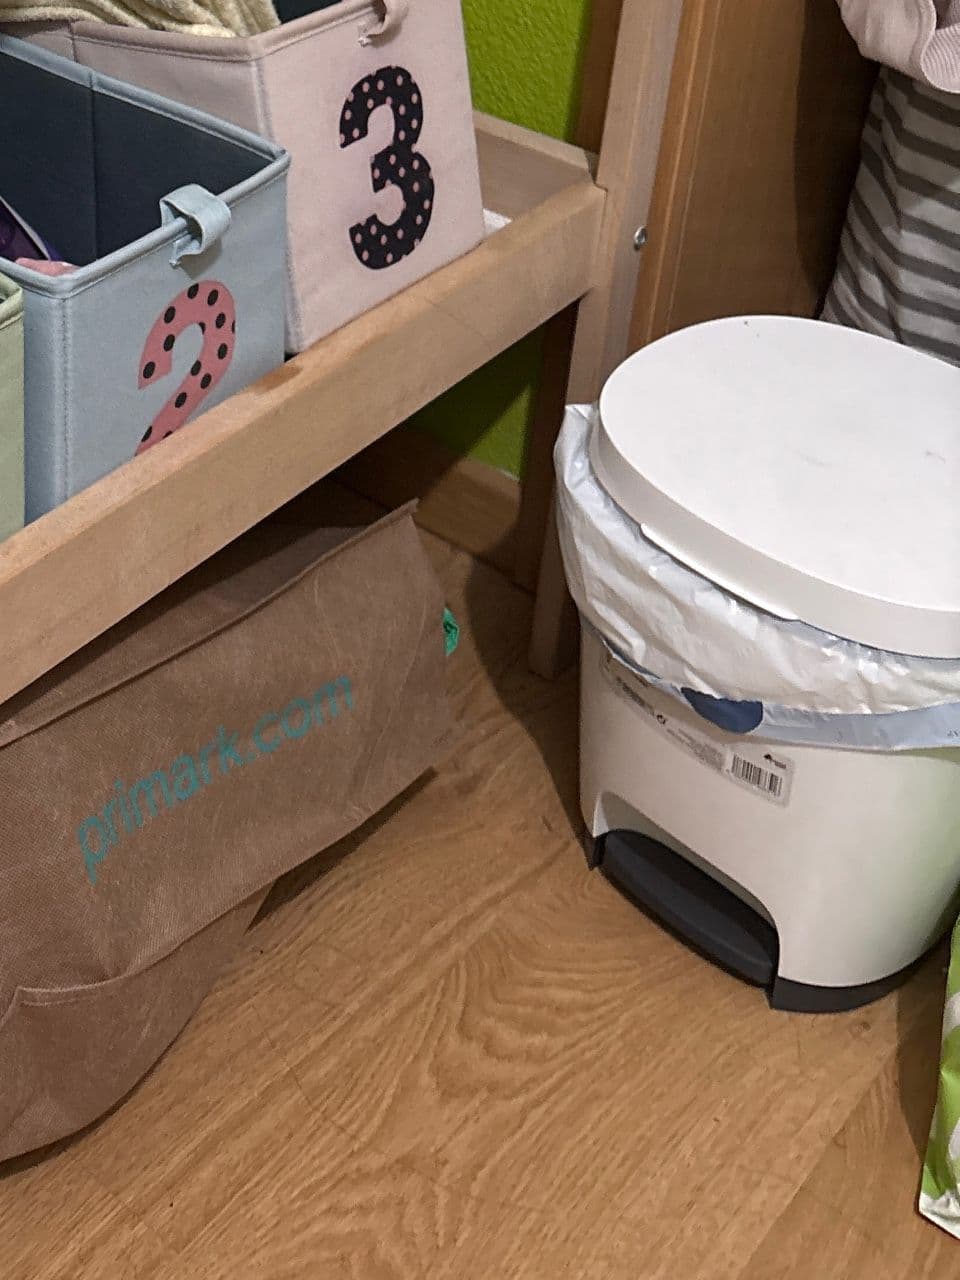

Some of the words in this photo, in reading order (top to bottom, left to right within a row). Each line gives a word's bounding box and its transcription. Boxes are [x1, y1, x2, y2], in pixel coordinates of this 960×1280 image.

[339, 66, 435, 270] 3
[135, 280, 236, 456] 2
[77, 675, 353, 886] primark.com
